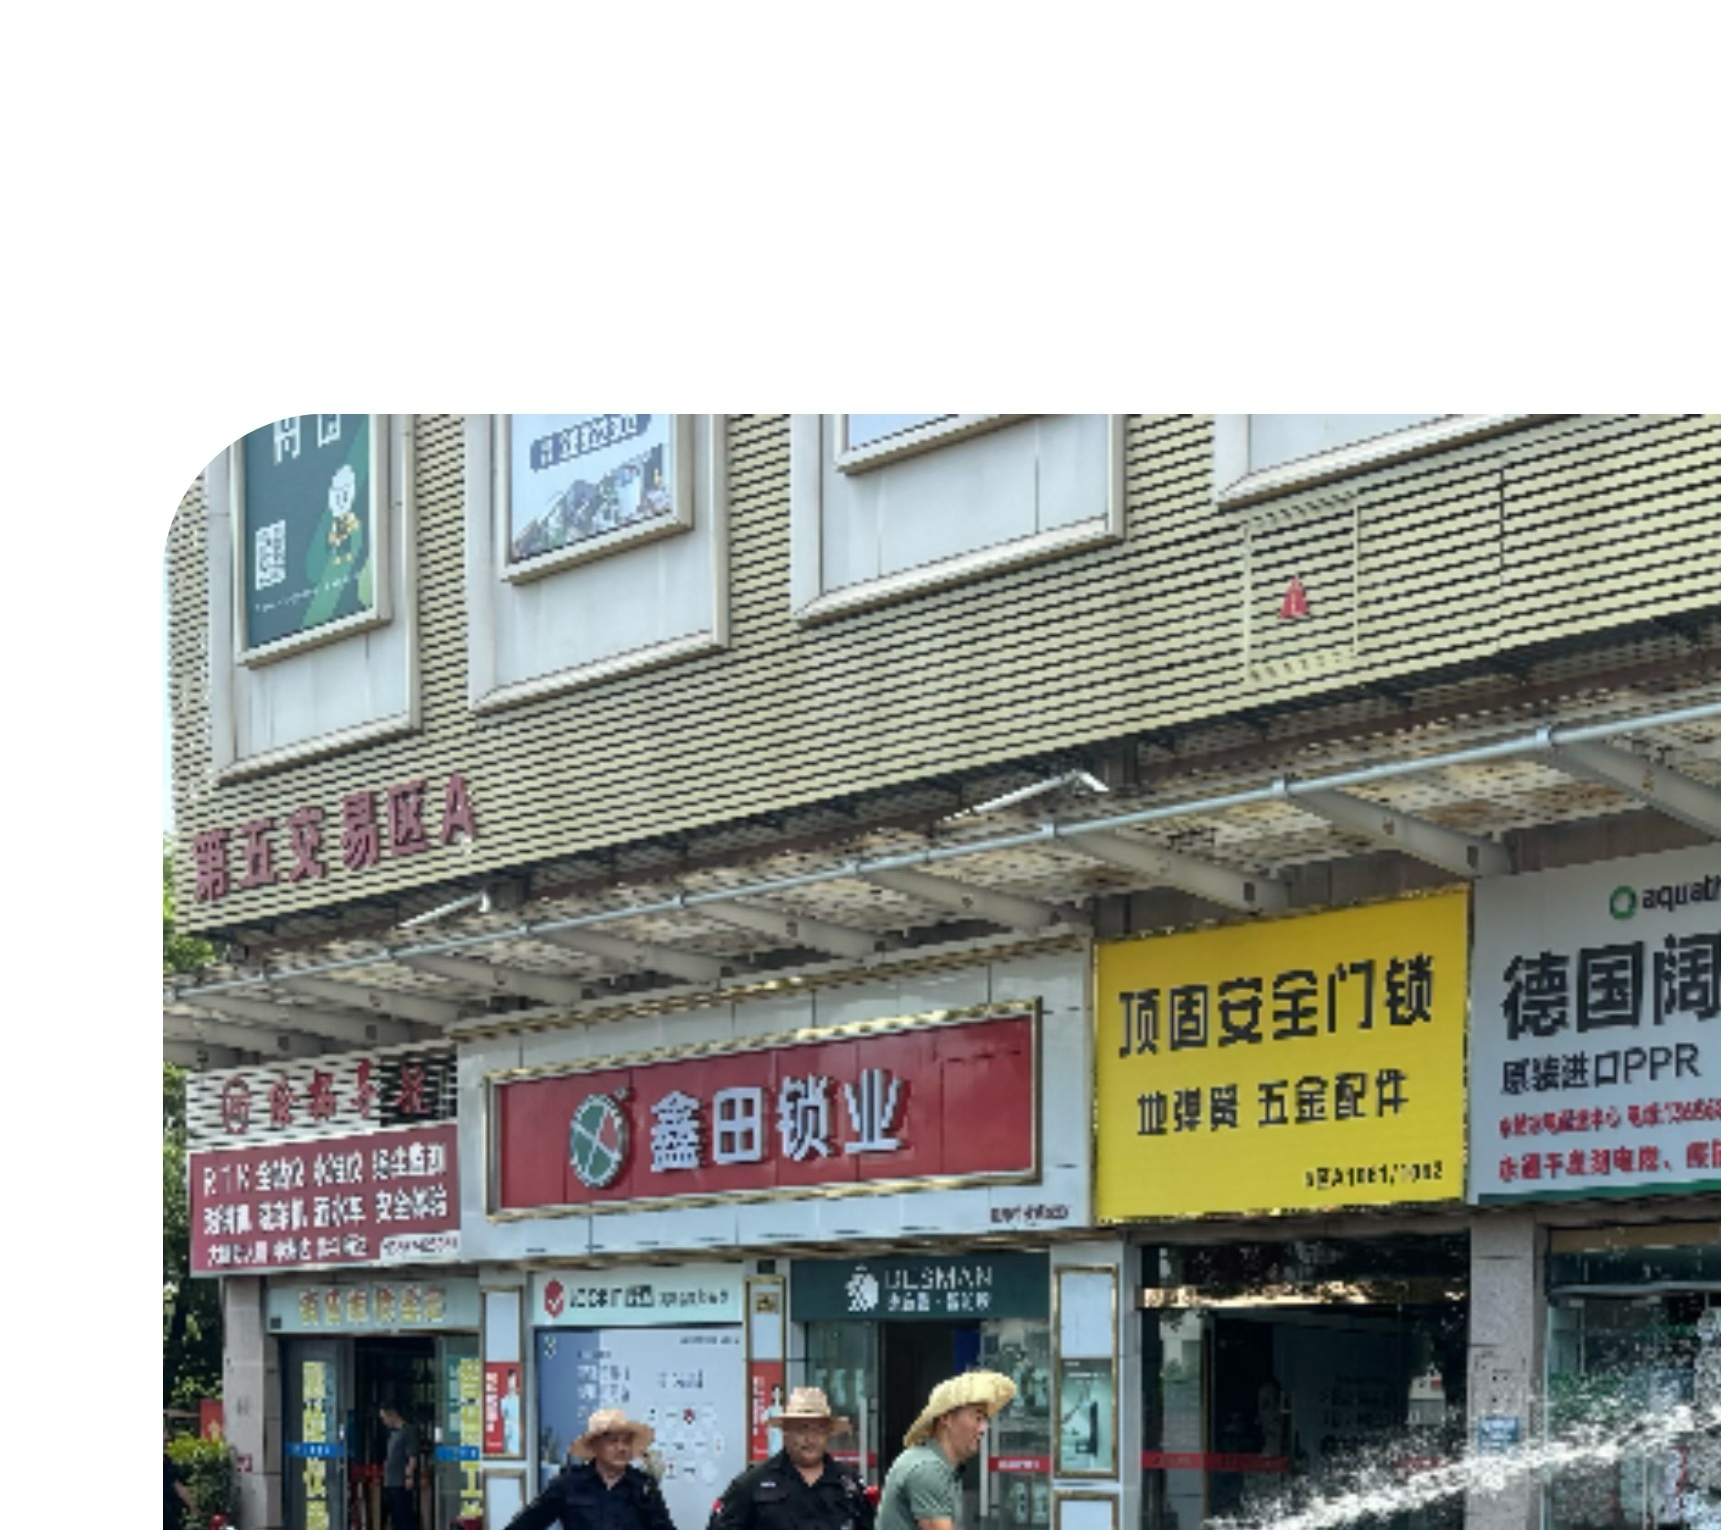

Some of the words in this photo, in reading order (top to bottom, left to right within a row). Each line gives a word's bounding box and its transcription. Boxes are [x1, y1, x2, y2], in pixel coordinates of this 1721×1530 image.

[193, 773, 475, 900] 第五交易区A
[1118, 952, 1435, 1058] 顶固安全门锁
[650, 1068, 902, 1174] 鑫田锁业
[1137, 1082, 1239, 1137] 地弹簧
[1257, 1067, 1409, 1128] 五金配件
[1501, 1043, 1701, 1096] 原装进口PPR
